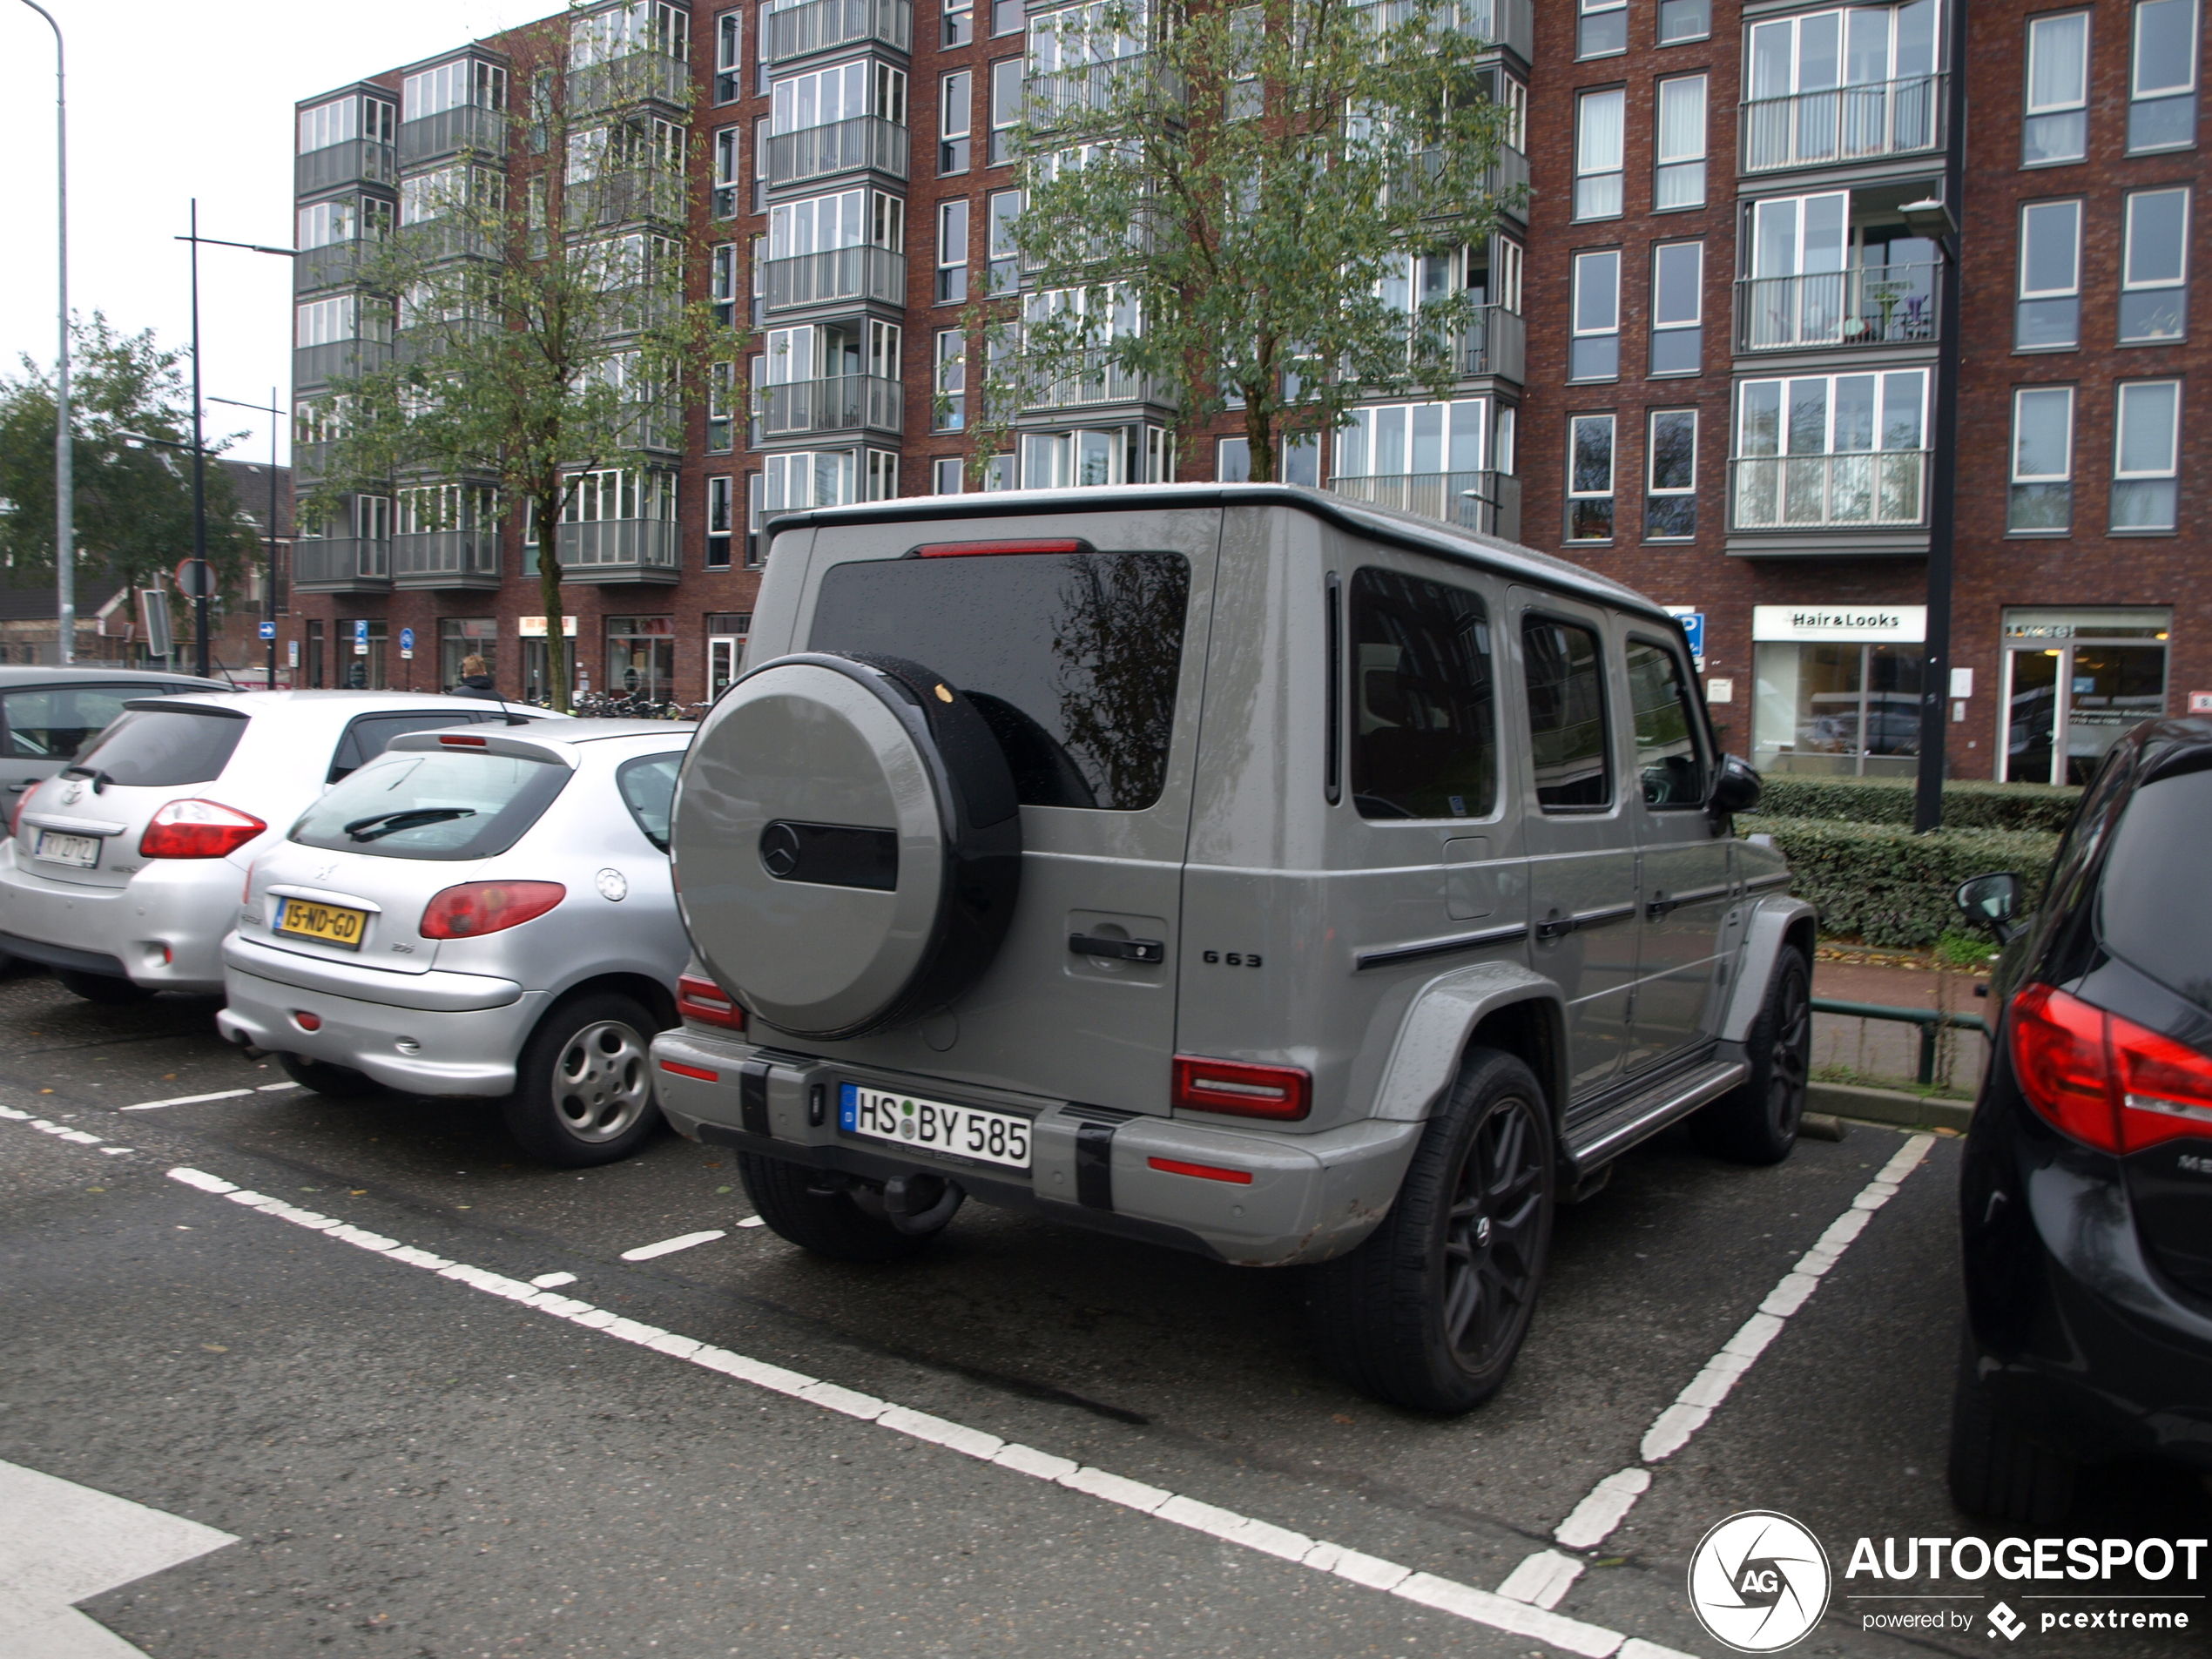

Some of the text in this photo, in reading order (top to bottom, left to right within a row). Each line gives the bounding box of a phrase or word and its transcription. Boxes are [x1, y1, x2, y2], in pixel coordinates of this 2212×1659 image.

[286, 903, 356, 938] 15-ND-GD
[1203, 950, 1262, 968] G 63
[859, 1092, 1028, 1161] HS BY 585
